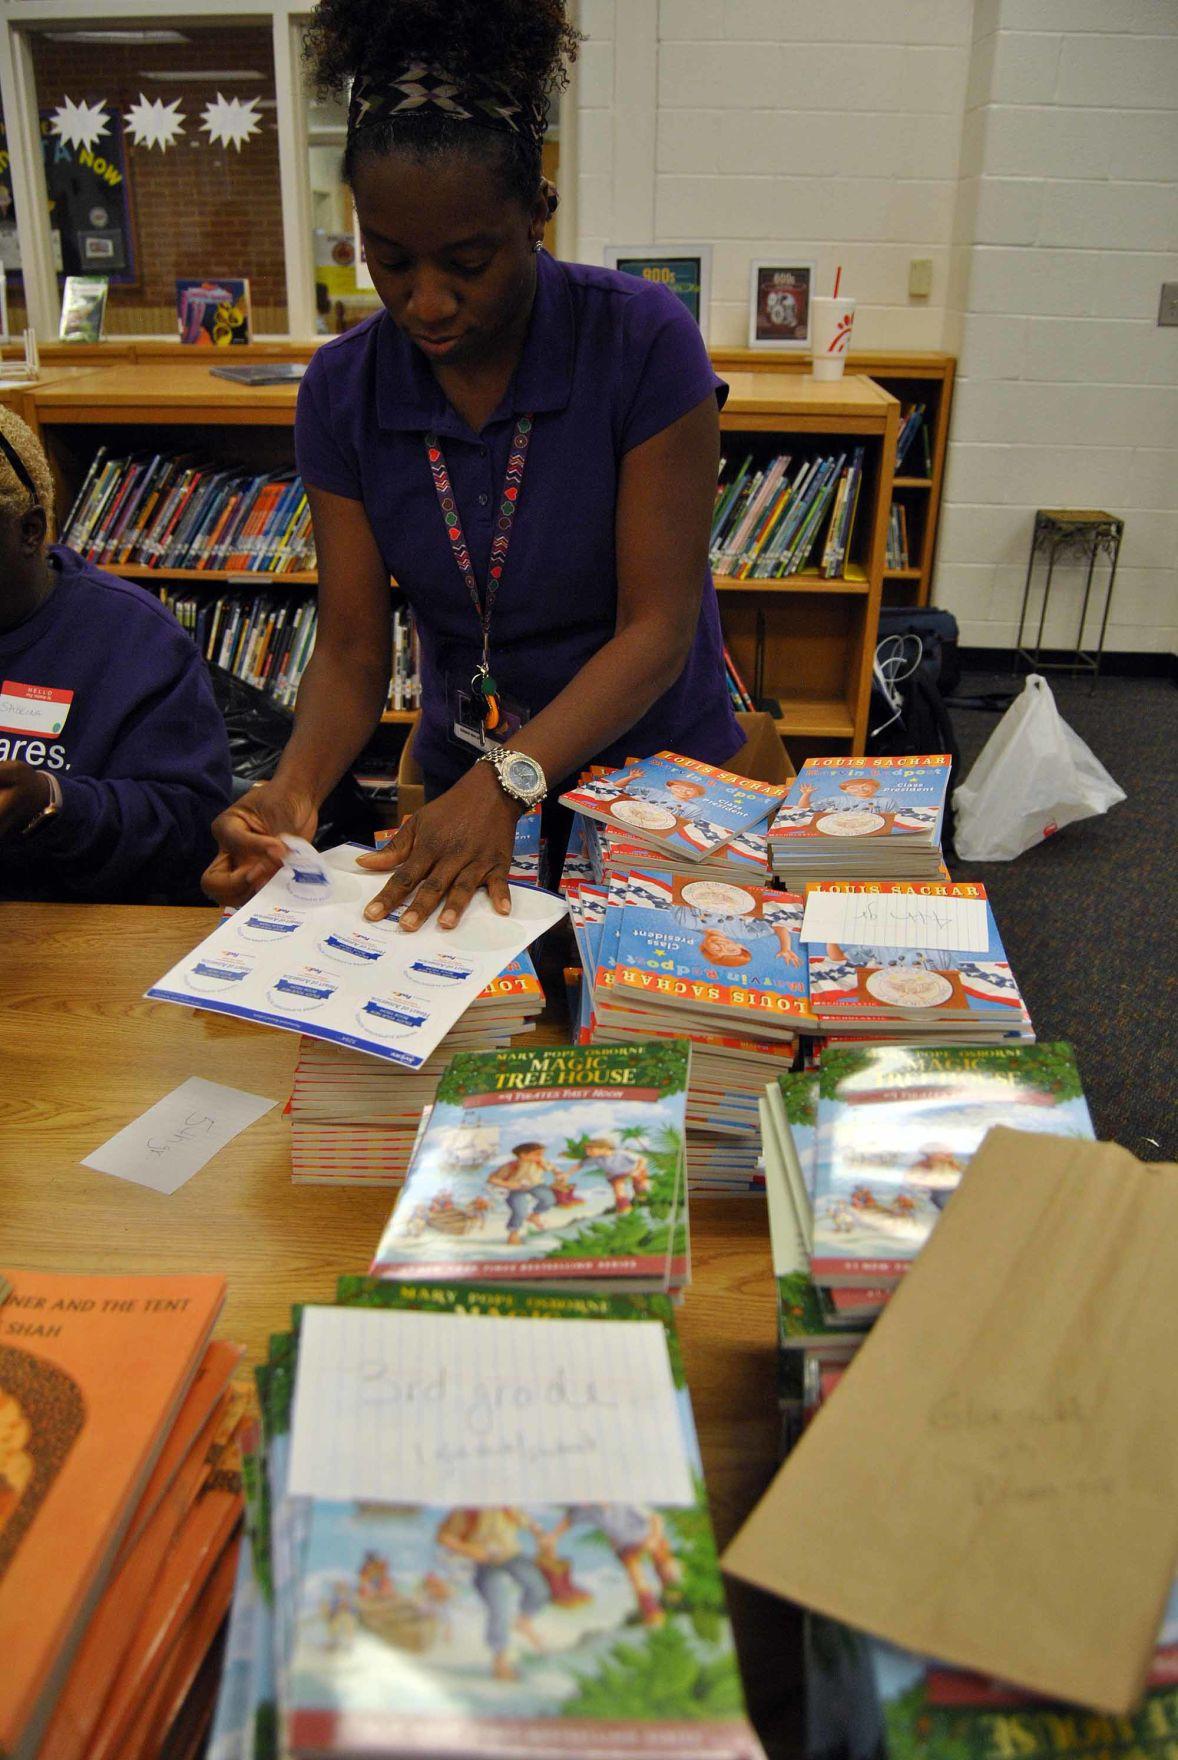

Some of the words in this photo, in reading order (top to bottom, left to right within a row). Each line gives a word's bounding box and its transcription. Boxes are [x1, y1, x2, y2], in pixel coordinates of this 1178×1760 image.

[79, 148, 122, 186] NOW
[642, 267, 676, 284] 900s
[27, 688, 53, 696] HELLO
[873, 757, 946, 766] SACHAR
[664, 753, 714, 774] LOUIS
[717, 772, 788, 798] SACHAR
[718, 799, 743, 812] Class
[816, 885, 880, 895] LOUIS
[891, 885, 980, 897] SACHAR
[647, 938, 680, 950] Class
[486, 979, 528, 993] LOU
[621, 970, 719, 999] SACHAR
[731, 991, 806, 1014] LOUIS
[496, 1052, 535, 1060] MARY
[543, 1050, 576, 1058] POPE
[585, 1047, 646, 1056] OSBORNE
[959, 1048, 1024, 1057] OSBORNE
[530, 1056, 607, 1072] MAGIC
[496, 1071, 553, 1089] TREE
[557, 1068, 637, 1085] HOUSE
[50, 1299, 96, 1313] AND
[100, 1300, 136, 1313] THE
[144, 1299, 190, 1313] TENT
[7, 1321, 62, 1338] SHAH
